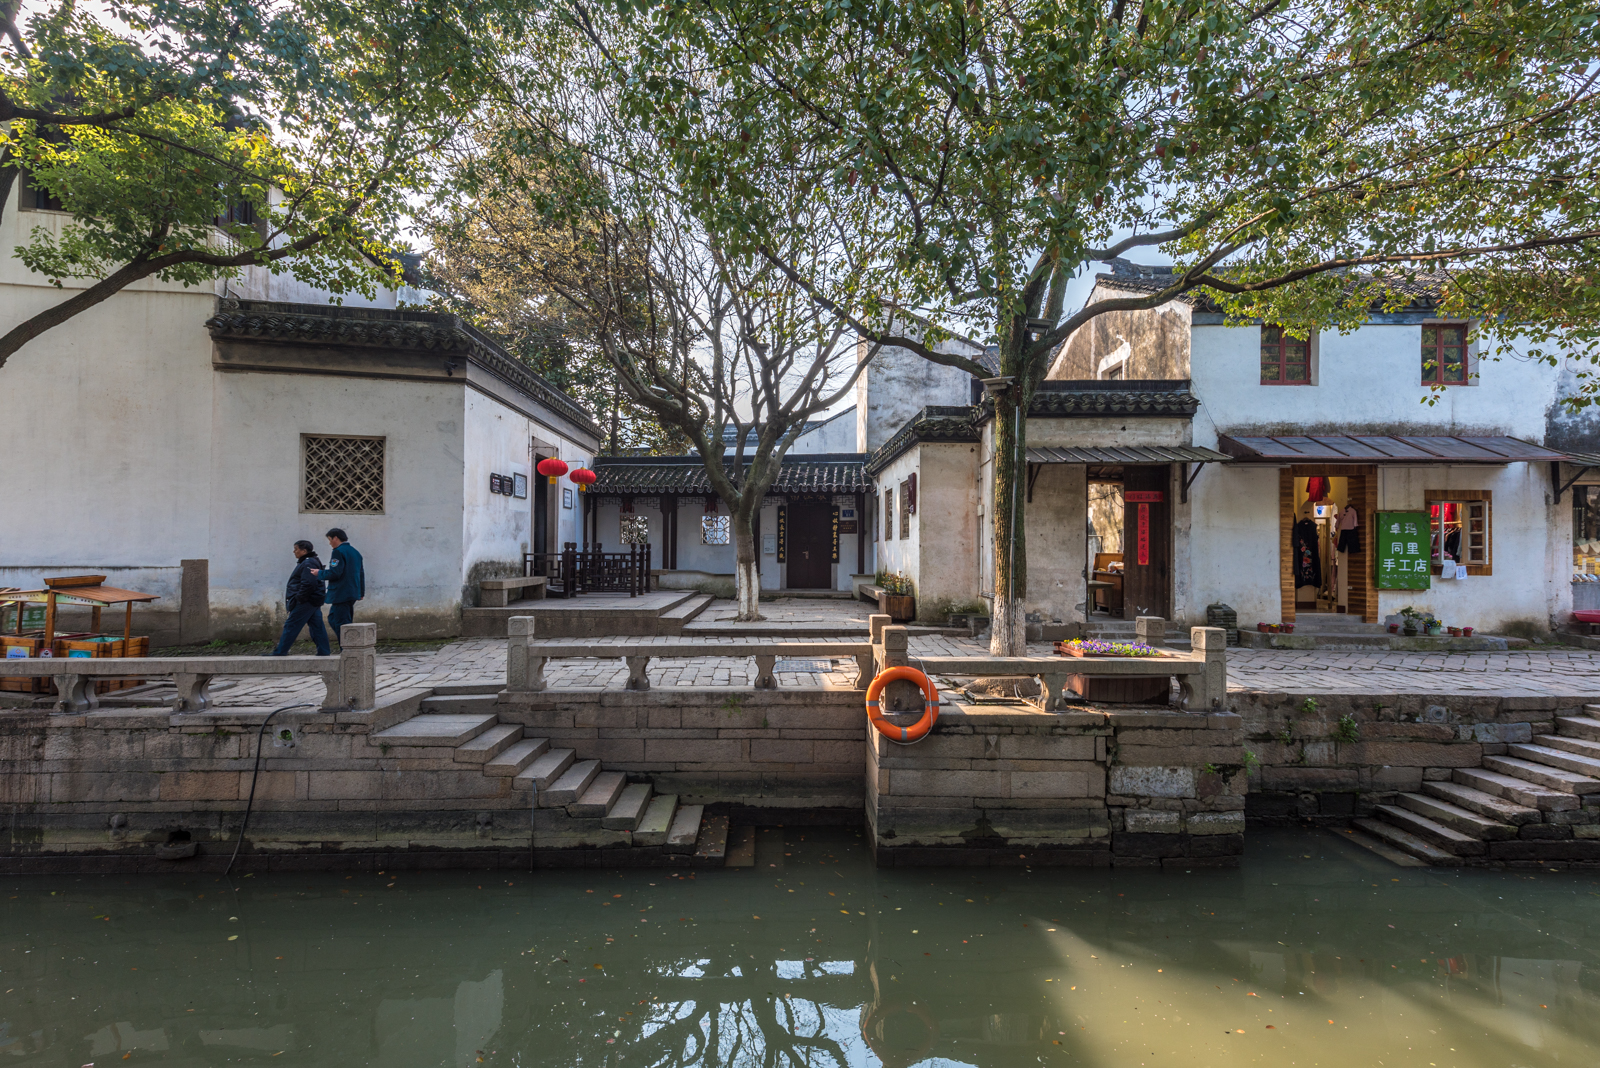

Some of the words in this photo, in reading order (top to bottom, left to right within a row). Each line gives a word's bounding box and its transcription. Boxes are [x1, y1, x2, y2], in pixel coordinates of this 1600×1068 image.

[1389, 522, 1418, 536] 卓玛
[1391, 541, 1420, 555] 同里
[1382, 558, 1427, 573] 手工店
